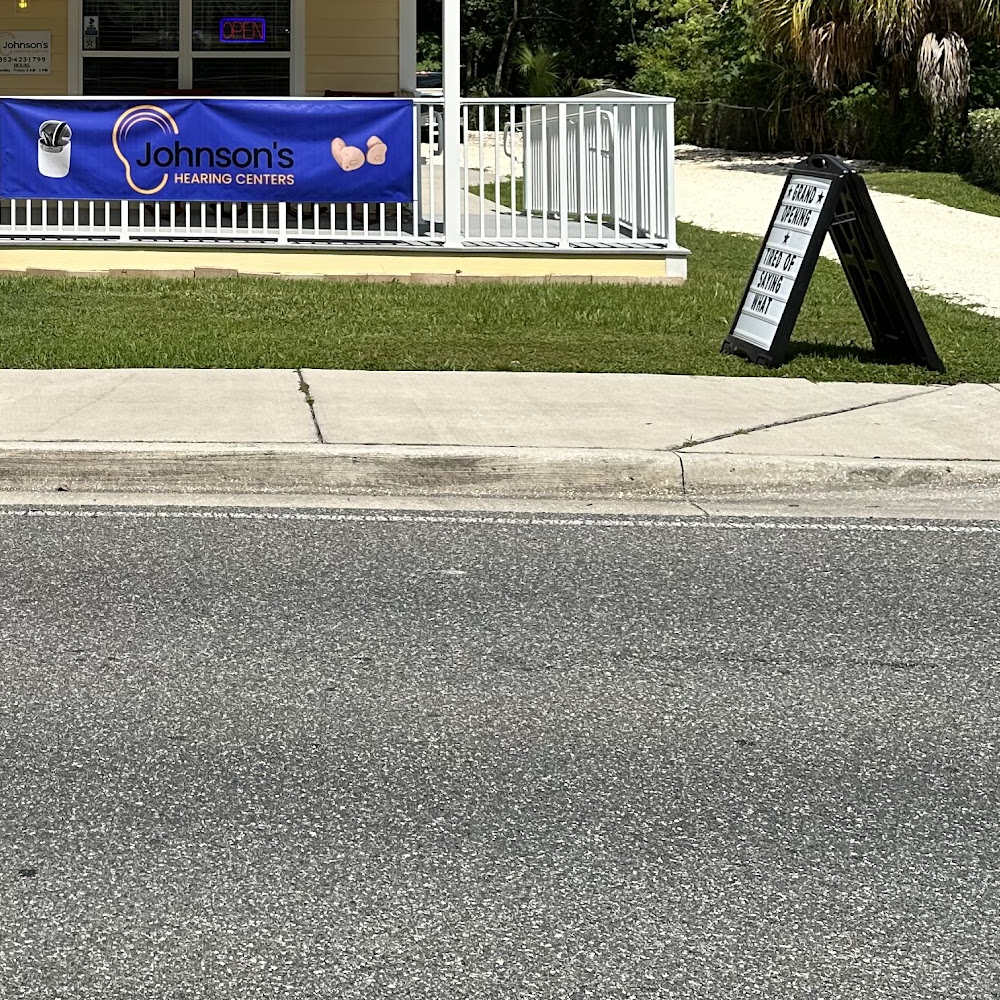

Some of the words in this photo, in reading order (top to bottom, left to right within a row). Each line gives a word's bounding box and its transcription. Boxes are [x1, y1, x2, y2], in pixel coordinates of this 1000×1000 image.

[223, 21, 263, 39] OPEN
[3, 41, 48, 49] Johnson's
[136, 141, 295, 169] Johnson's
[174, 172, 233, 185] HEARING
[235, 173, 295, 186] CENTERS
[792, 184, 816, 204] GRAND
[780, 205, 812, 227] OPENING
[763, 248, 783, 268] TIRED
[783, 254, 796, 271] OF
[757, 271, 783, 293] SAYING
[751, 293, 773, 314] WHAT
